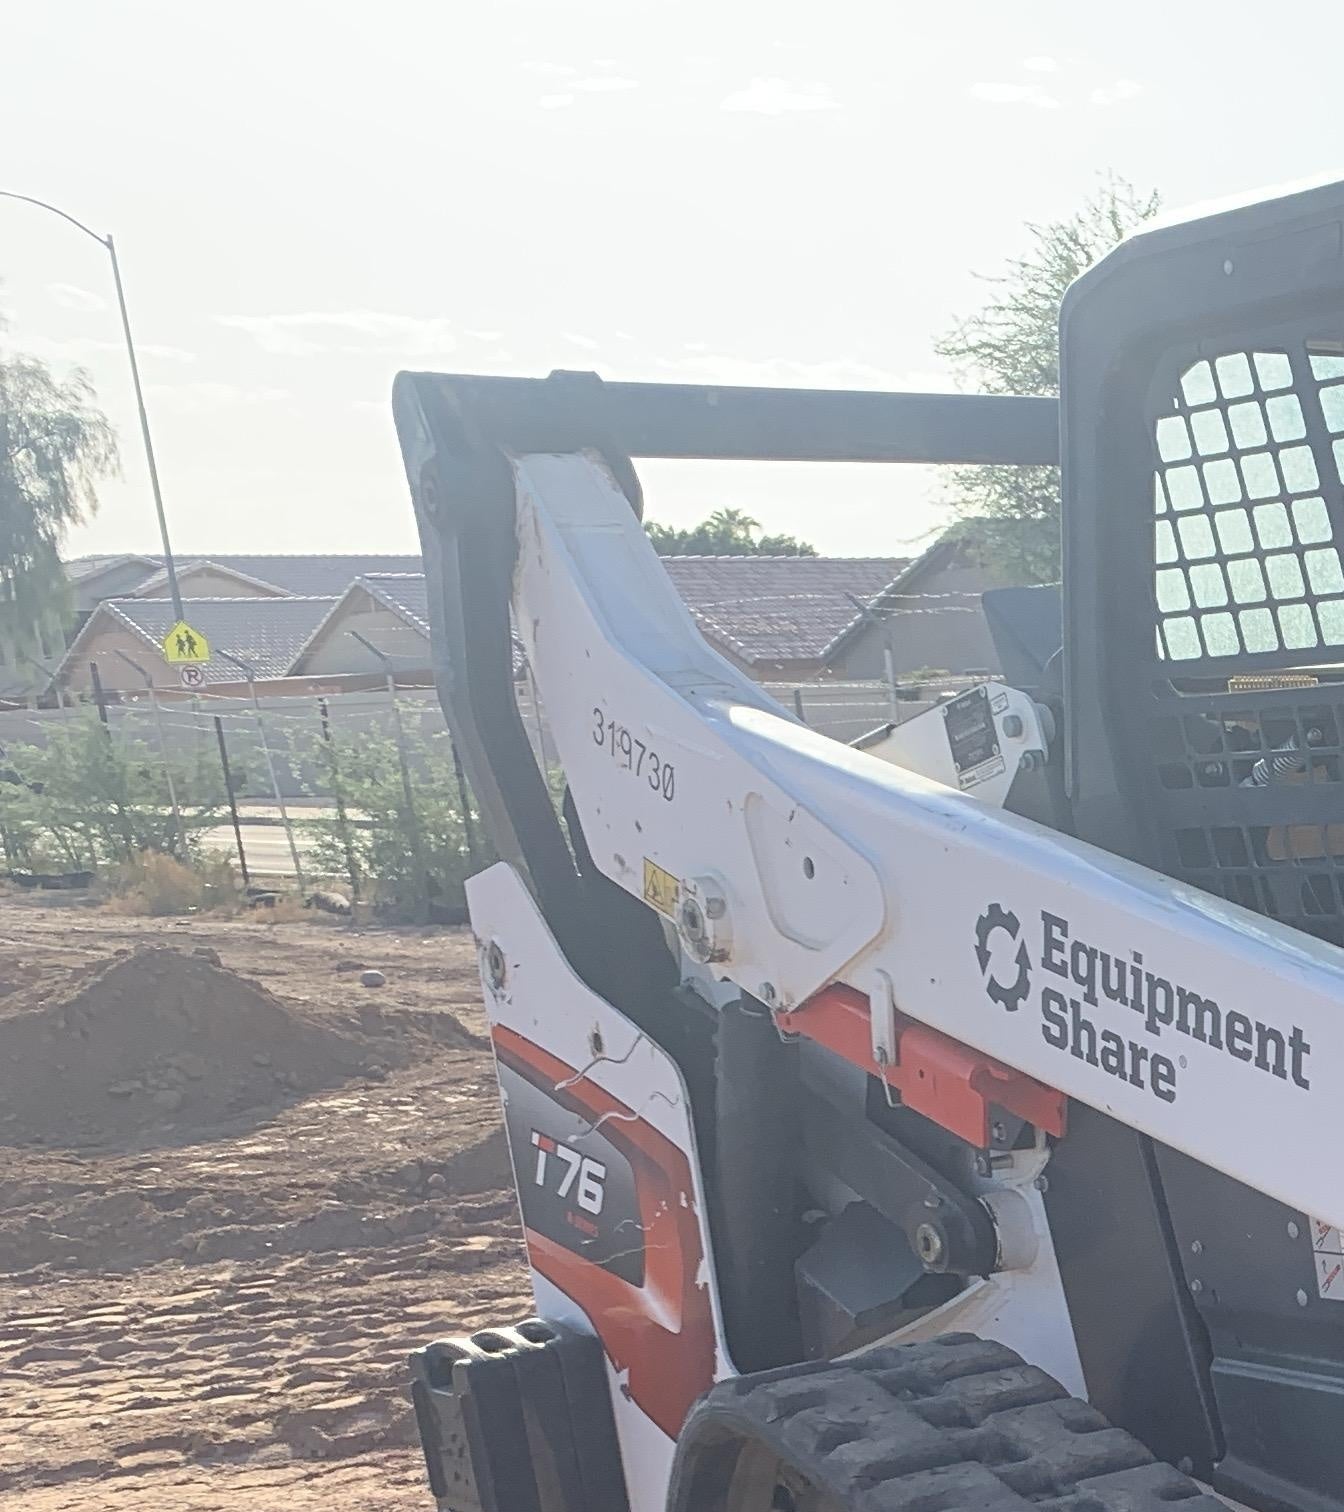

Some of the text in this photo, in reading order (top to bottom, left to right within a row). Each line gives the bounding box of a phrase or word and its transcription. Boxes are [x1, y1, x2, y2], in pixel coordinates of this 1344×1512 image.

[592, 707, 675, 802] 319730
[1040, 909, 1311, 1091] Equipment
[1040, 986, 1176, 1104] Share
[531, 1131, 606, 1215] T76
